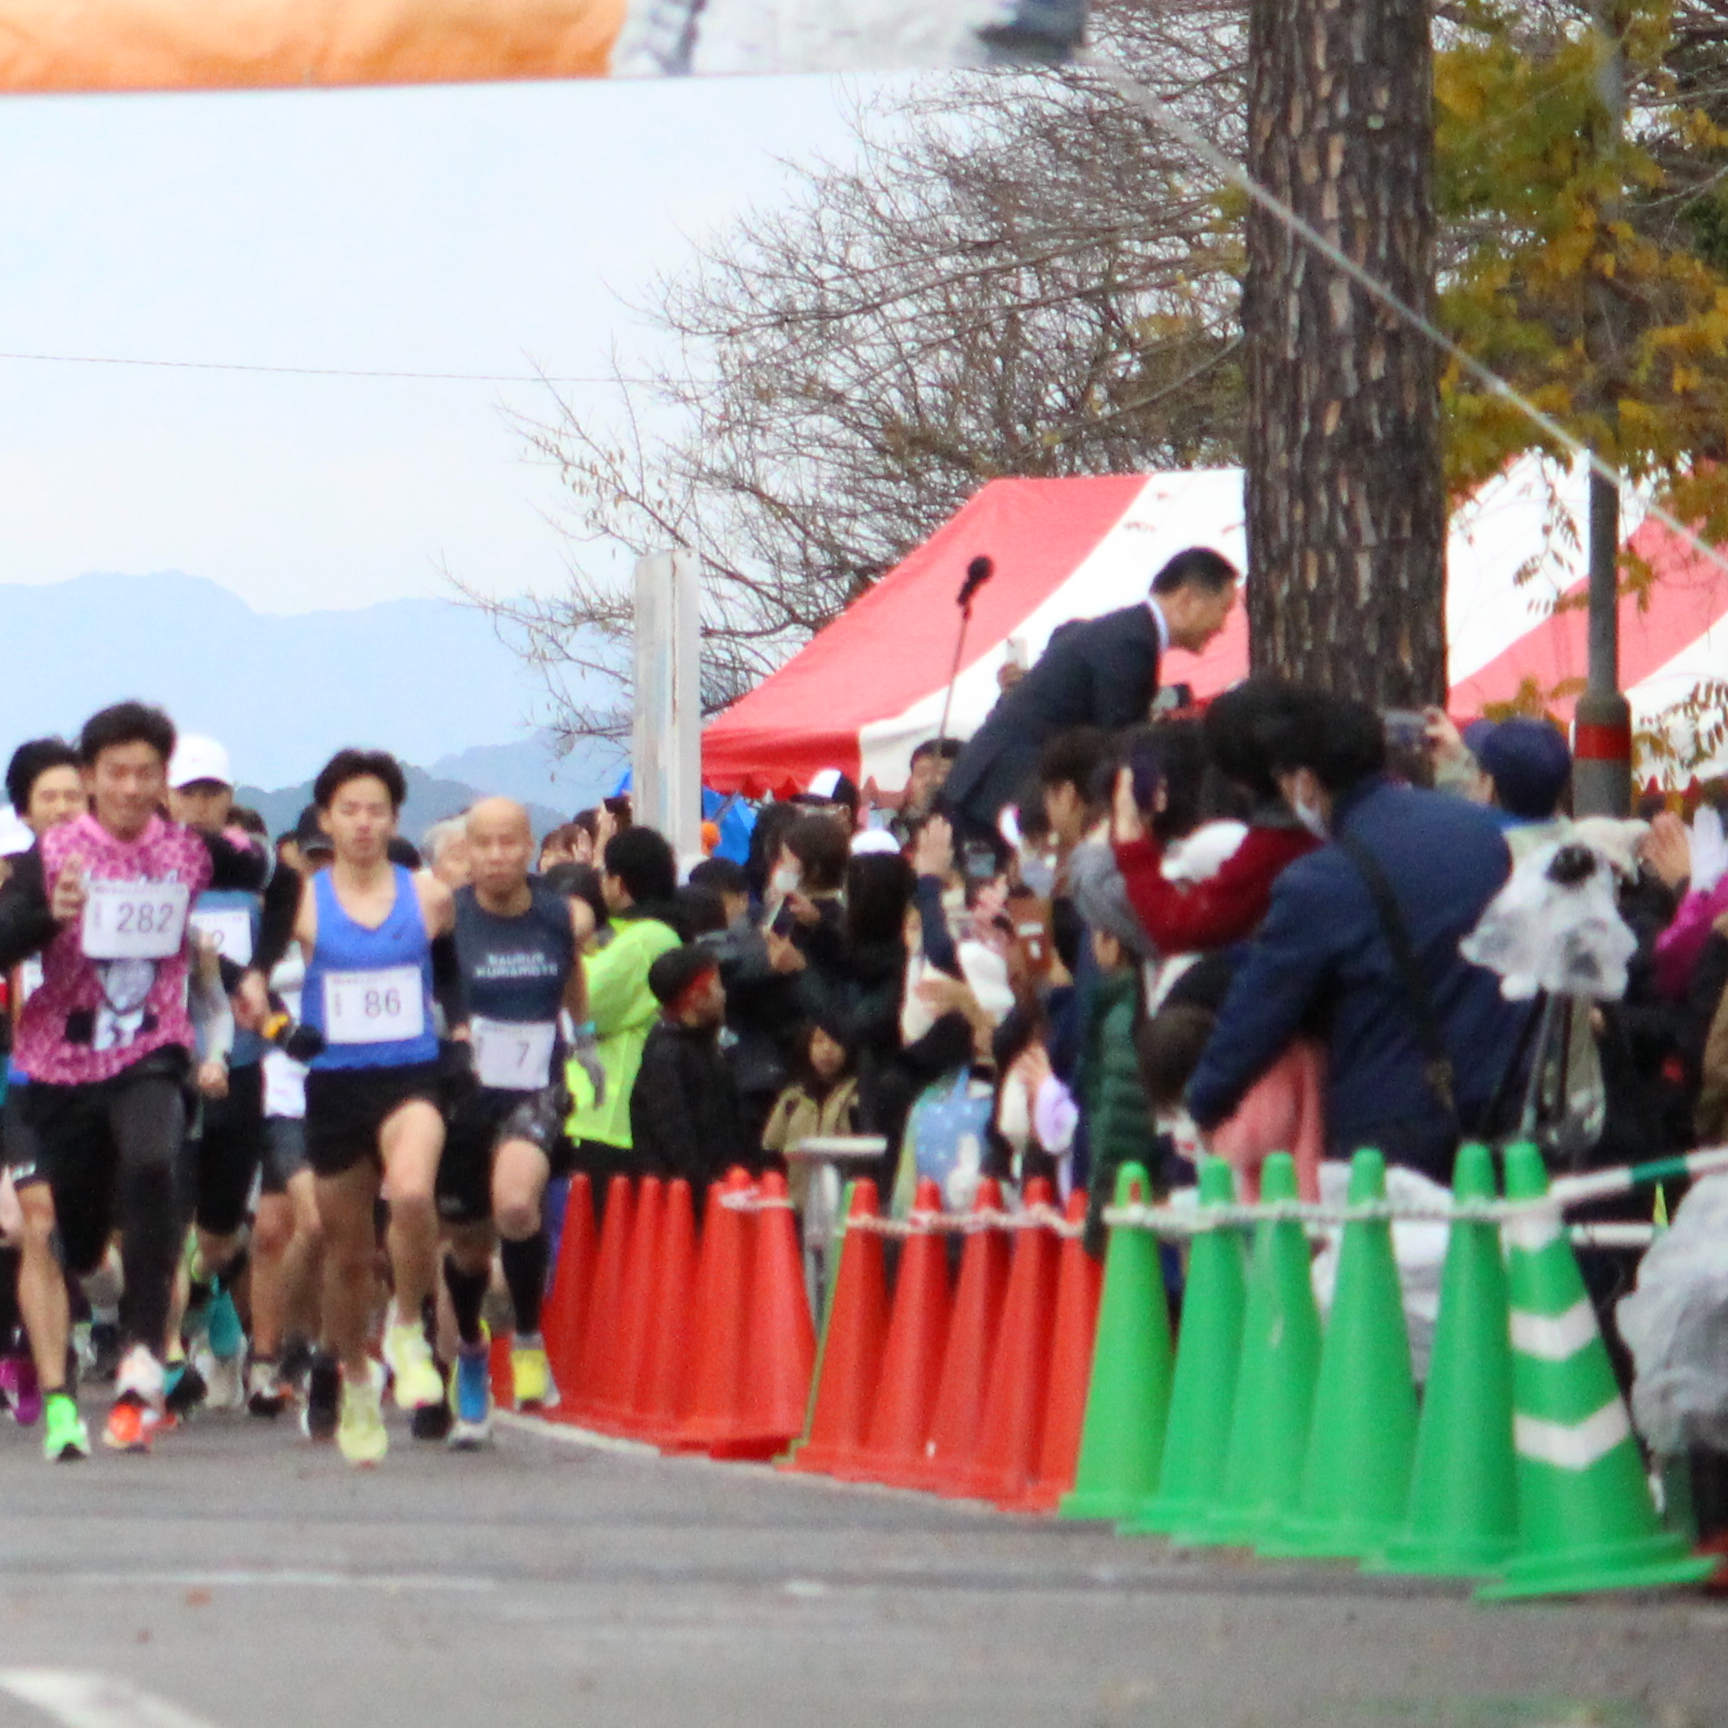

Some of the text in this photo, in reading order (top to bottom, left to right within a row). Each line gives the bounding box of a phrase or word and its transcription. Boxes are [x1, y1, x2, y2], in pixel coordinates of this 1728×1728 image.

[117, 902, 175, 935] 282
[364, 988, 401, 1018] 86
[514, 1040, 530, 1069] 7
